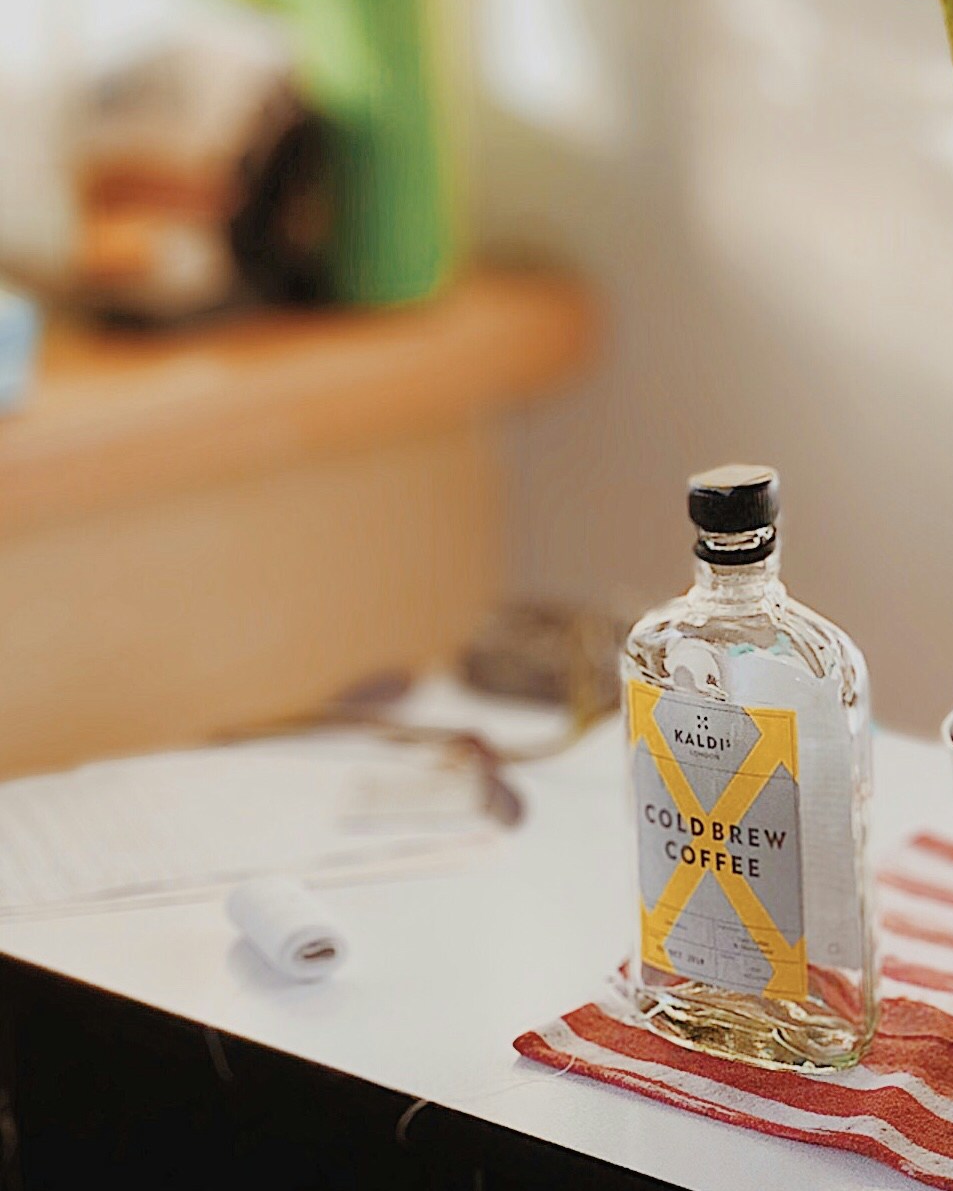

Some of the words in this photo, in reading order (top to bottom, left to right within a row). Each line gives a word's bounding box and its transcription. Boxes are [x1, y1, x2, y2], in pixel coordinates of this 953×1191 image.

[644, 803, 705, 837] COLD
[711, 820, 787, 850] BREW
[664, 840, 761, 878] COFFEE
